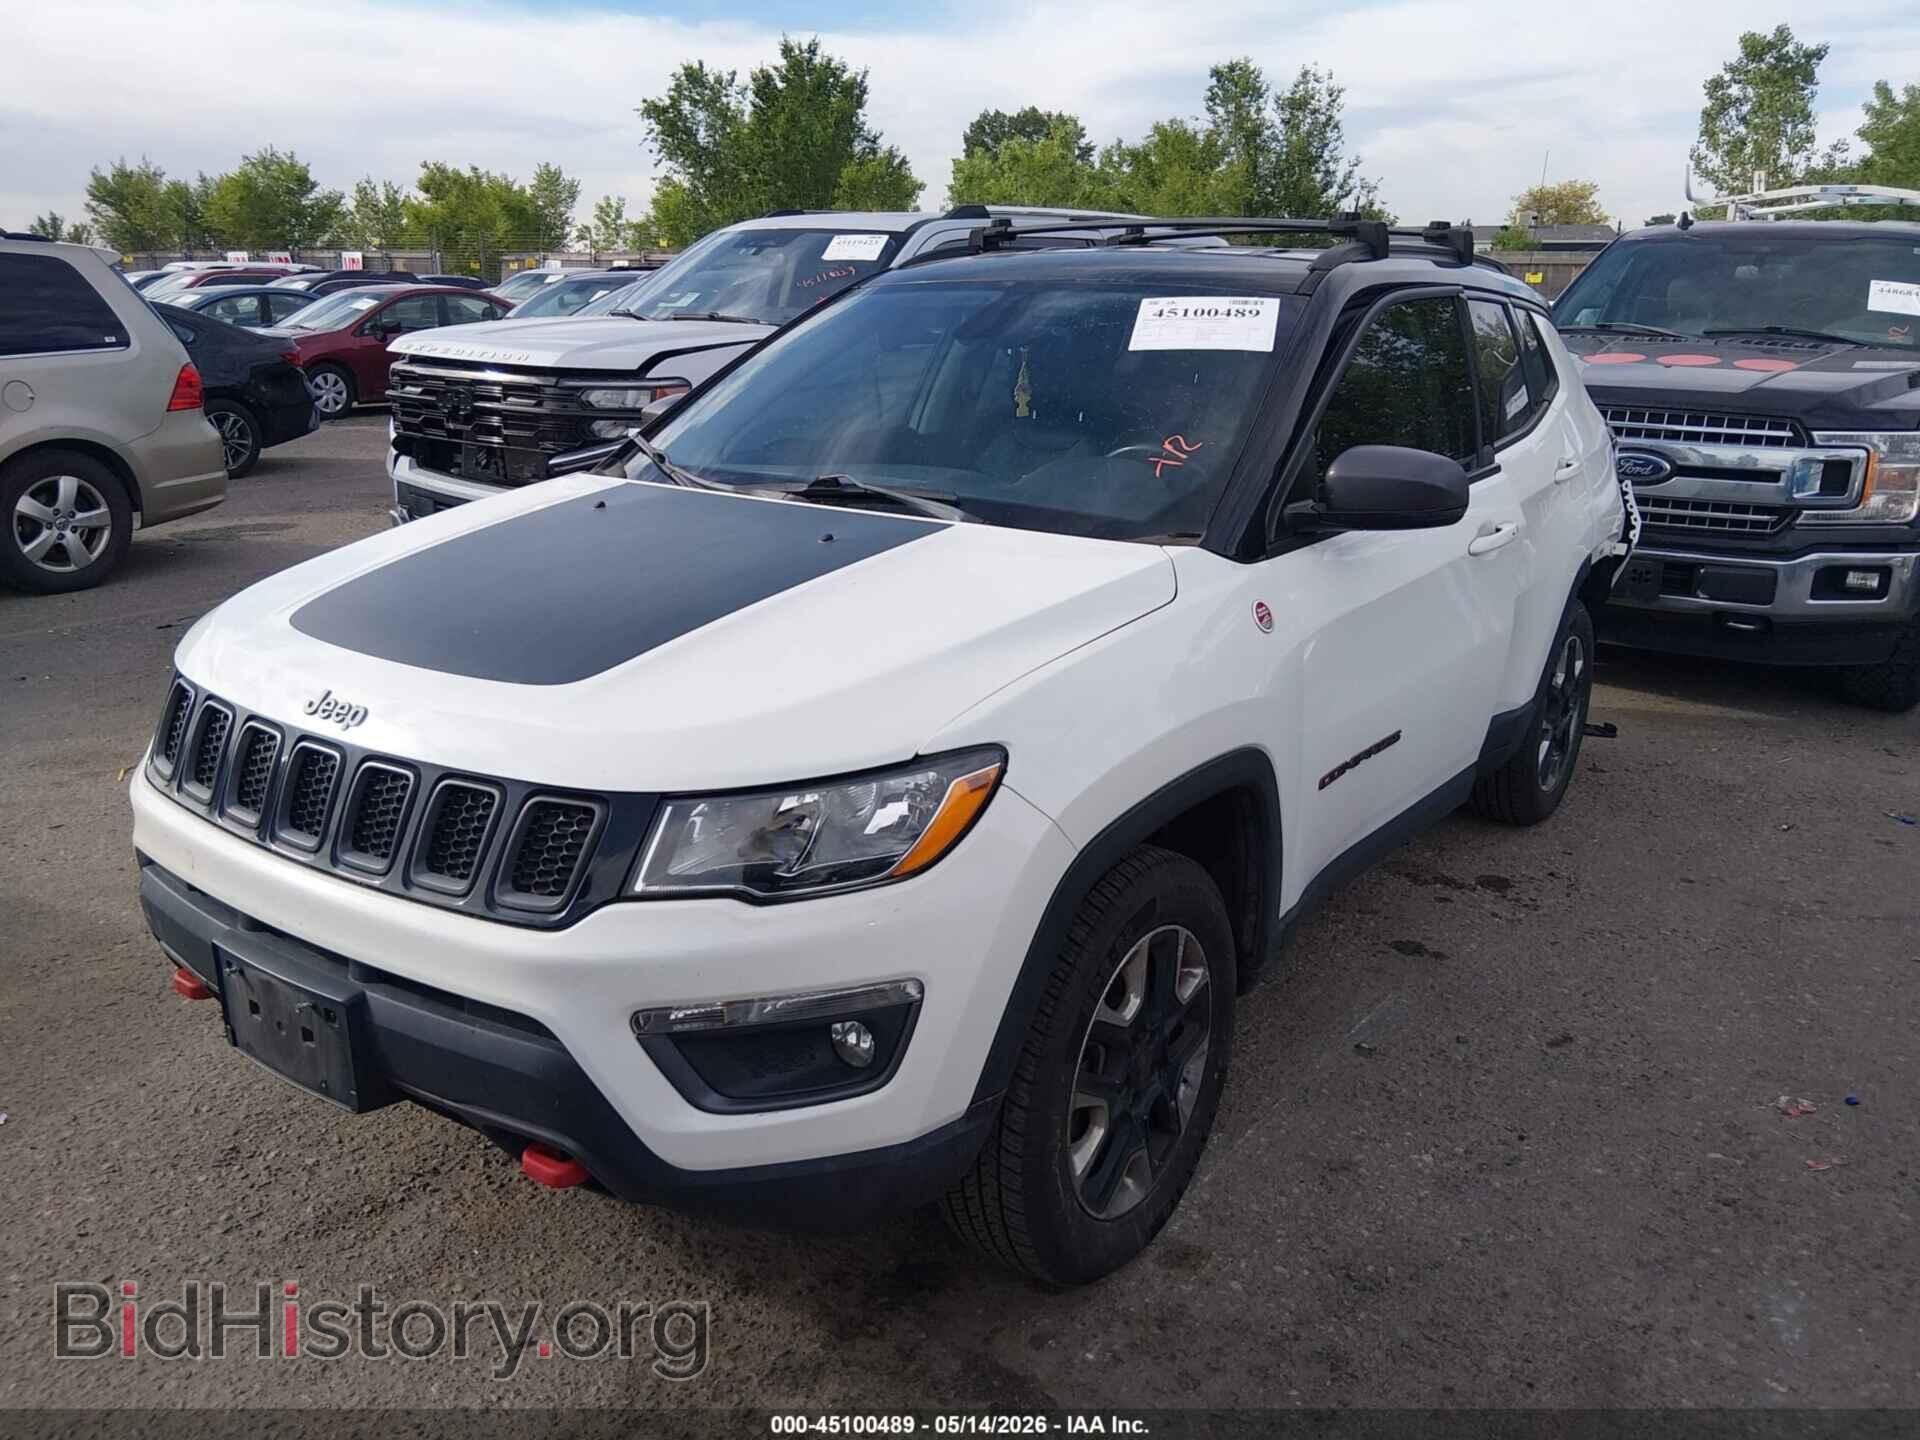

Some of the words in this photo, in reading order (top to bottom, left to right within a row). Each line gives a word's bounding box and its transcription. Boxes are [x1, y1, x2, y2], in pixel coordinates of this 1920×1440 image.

[1152, 308, 1261, 318] 45100489
[401, 343, 530, 362] EXPEDITION
[1617, 459, 1654, 475] Ford
[303, 690, 369, 732] Jeep
